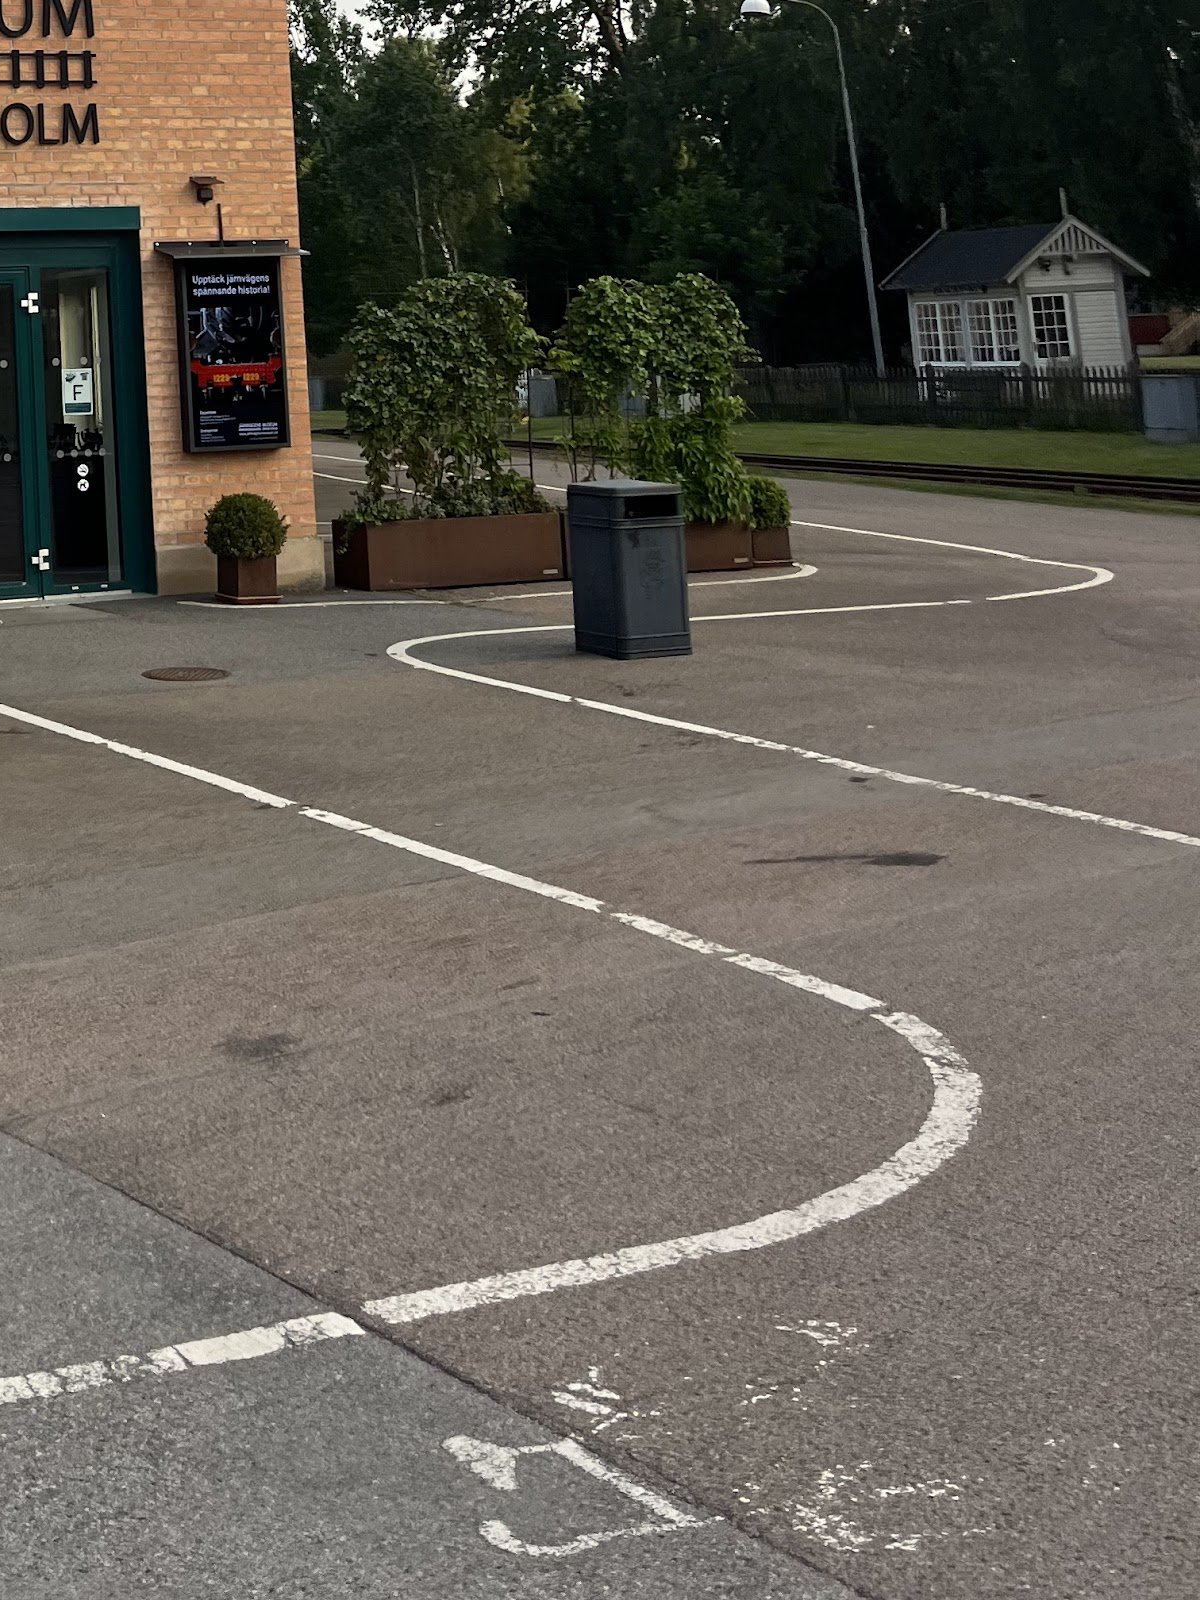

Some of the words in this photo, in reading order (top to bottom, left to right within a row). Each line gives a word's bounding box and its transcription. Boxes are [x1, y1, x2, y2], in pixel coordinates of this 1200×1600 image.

[192, 274, 225, 285] Upptäck
[193, 286, 237, 297] spännande
[238, 285, 271, 295] historia!
[73, 384, 84, 401] F
